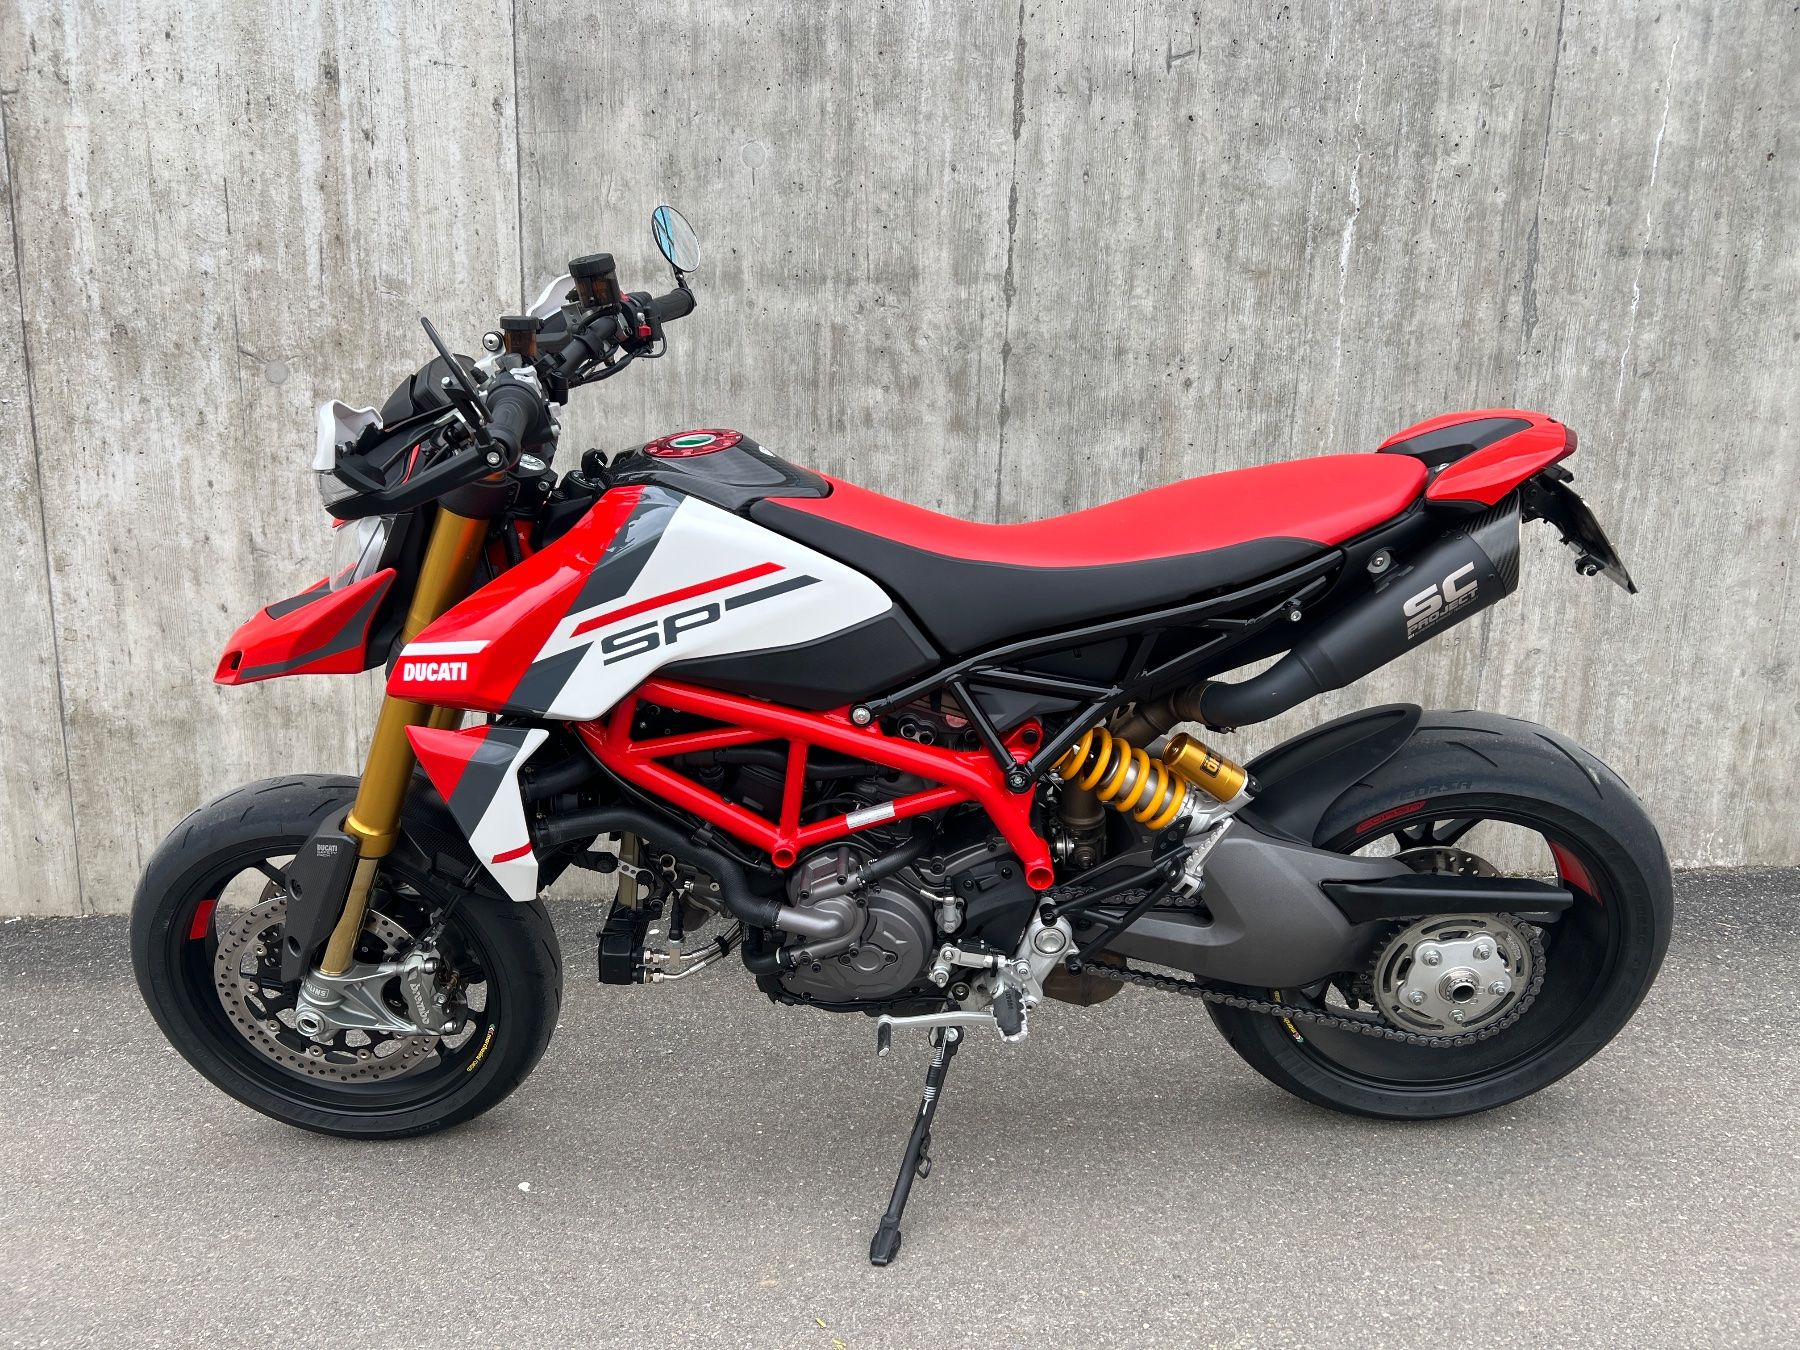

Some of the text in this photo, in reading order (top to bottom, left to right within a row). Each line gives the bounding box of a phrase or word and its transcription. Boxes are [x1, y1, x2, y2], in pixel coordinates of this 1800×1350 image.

[1403, 561, 1477, 628] SC
[1407, 588, 1478, 637] PROJECT
[601, 602, 721, 666] SP
[403, 661, 468, 682] DUCATI
[410, 983, 430, 1025] brembo
